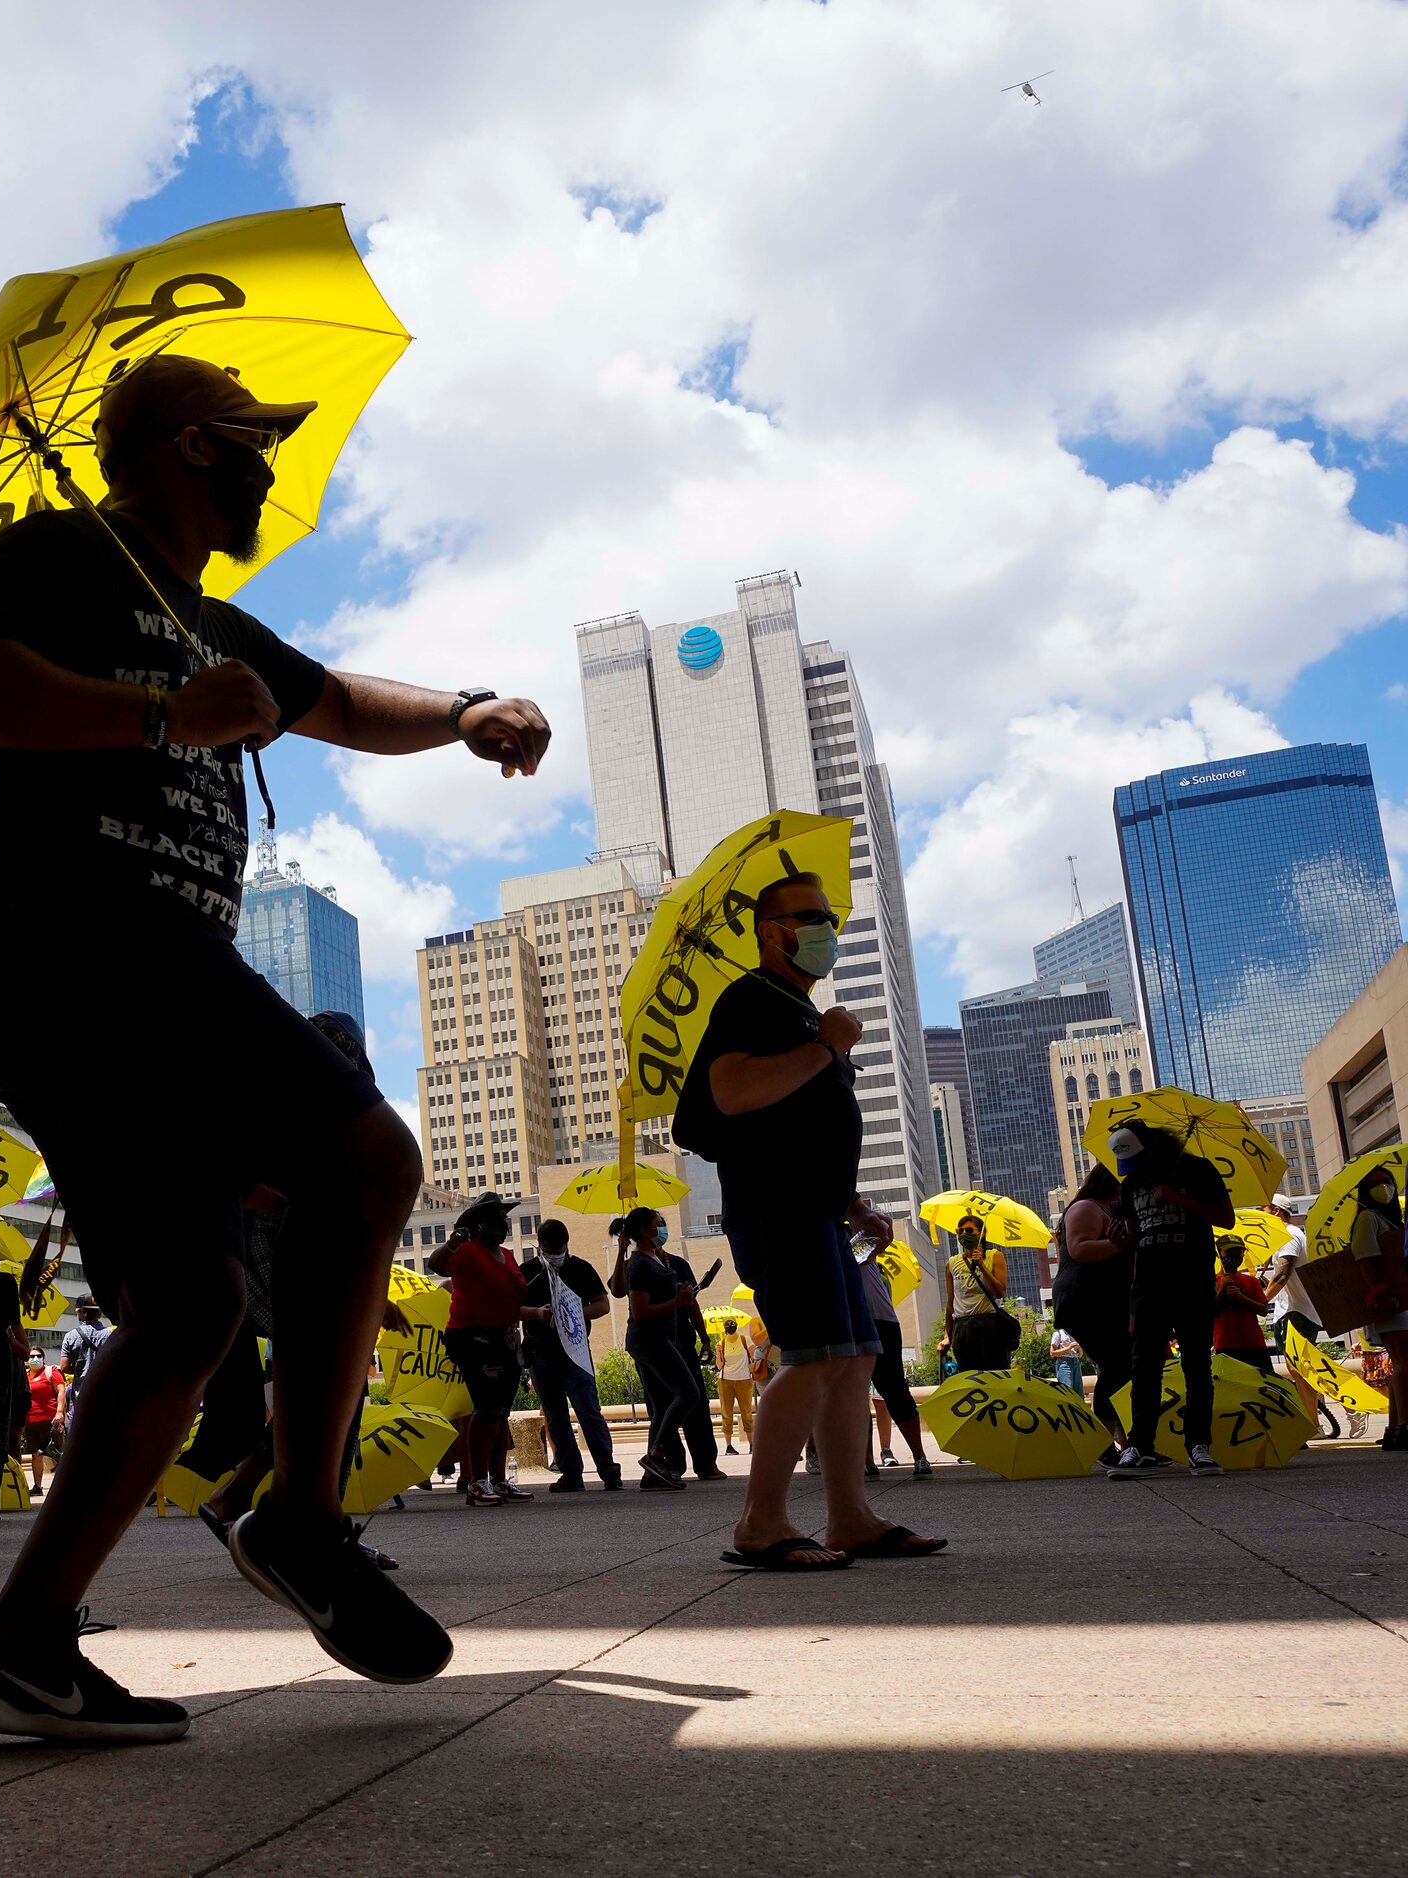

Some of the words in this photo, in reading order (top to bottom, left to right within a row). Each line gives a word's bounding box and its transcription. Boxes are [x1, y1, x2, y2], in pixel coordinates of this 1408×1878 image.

[134, 610, 179, 642] WE
[1192, 769, 1247, 785] Santander
[161, 786, 208, 817] WE
[98, 815, 225, 877] BLACK
[951, 1388, 1097, 1435] BROWN
